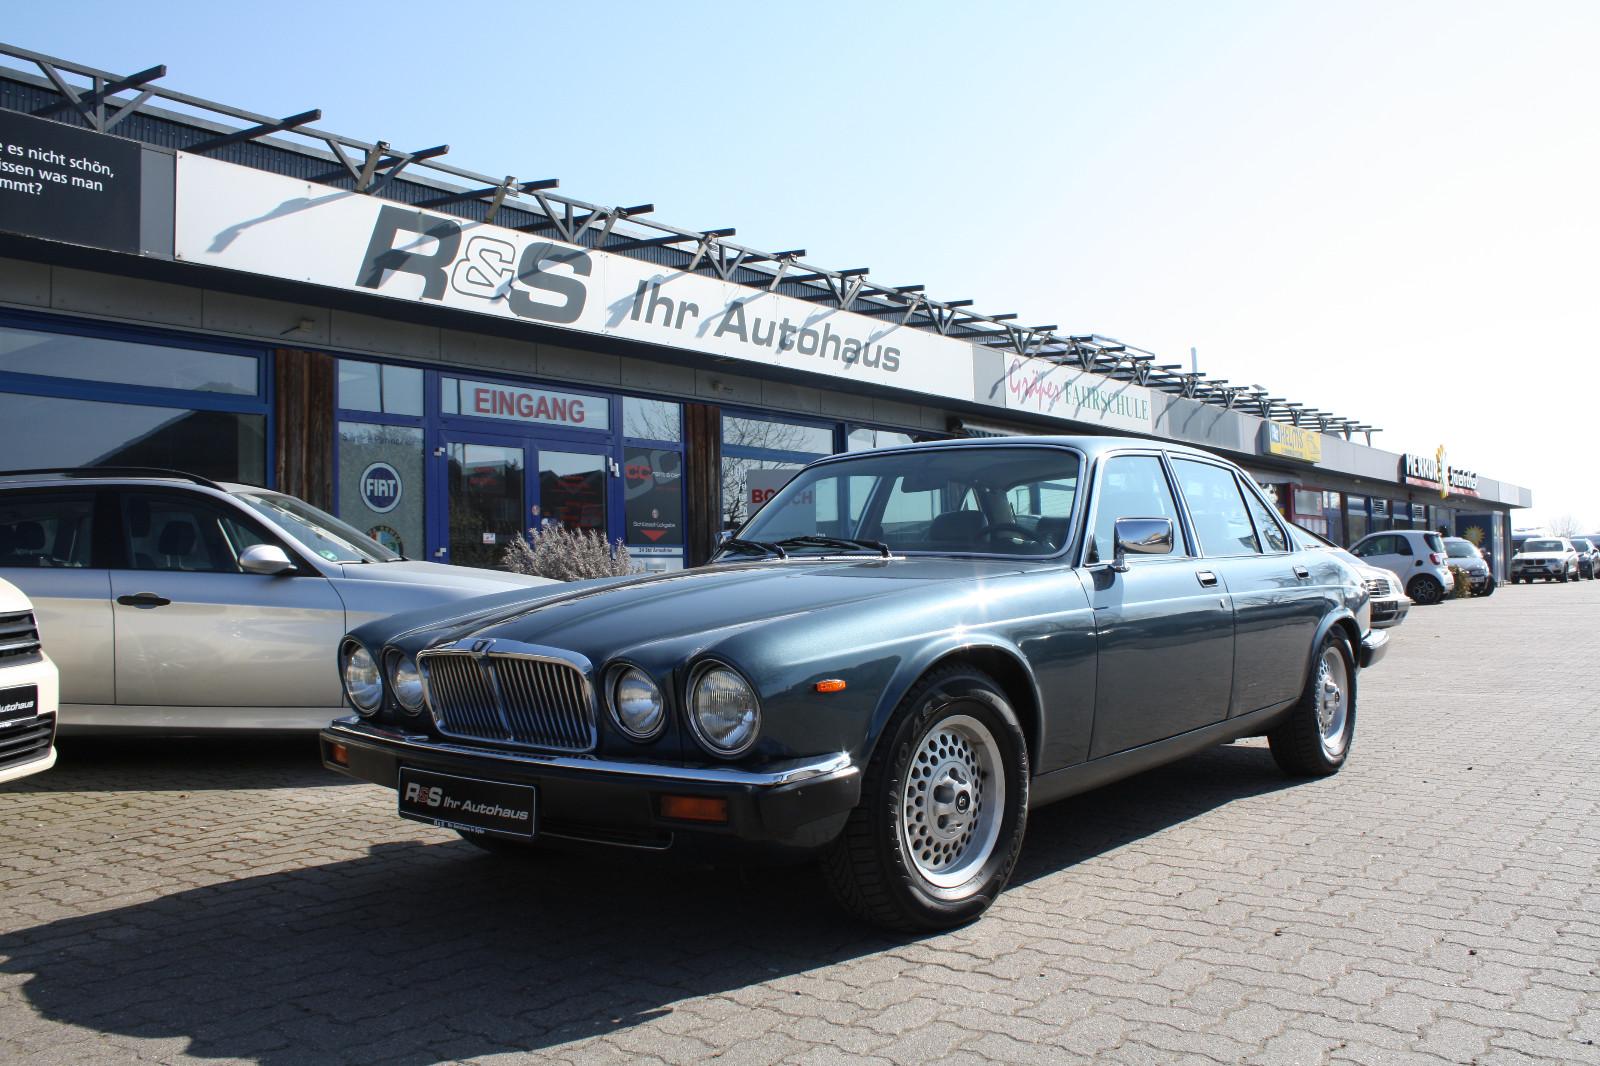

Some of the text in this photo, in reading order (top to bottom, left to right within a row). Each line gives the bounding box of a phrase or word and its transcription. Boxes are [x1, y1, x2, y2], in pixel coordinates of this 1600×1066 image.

[8, 144, 23, 156] es
[28, 148, 66, 166] nicht
[69, 158, 115, 178] schön,
[39, 169, 68, 184] was
[71, 177, 103, 191] man
[355, 204, 901, 372] R&S Ihr Autohaus
[475, 388, 585, 423] EINGANG
[1065, 382, 1149, 421] FAHRSCHULE
[366, 479, 396, 496] FIAT
[405, 782, 529, 820] R&S Ihr Autohaus
